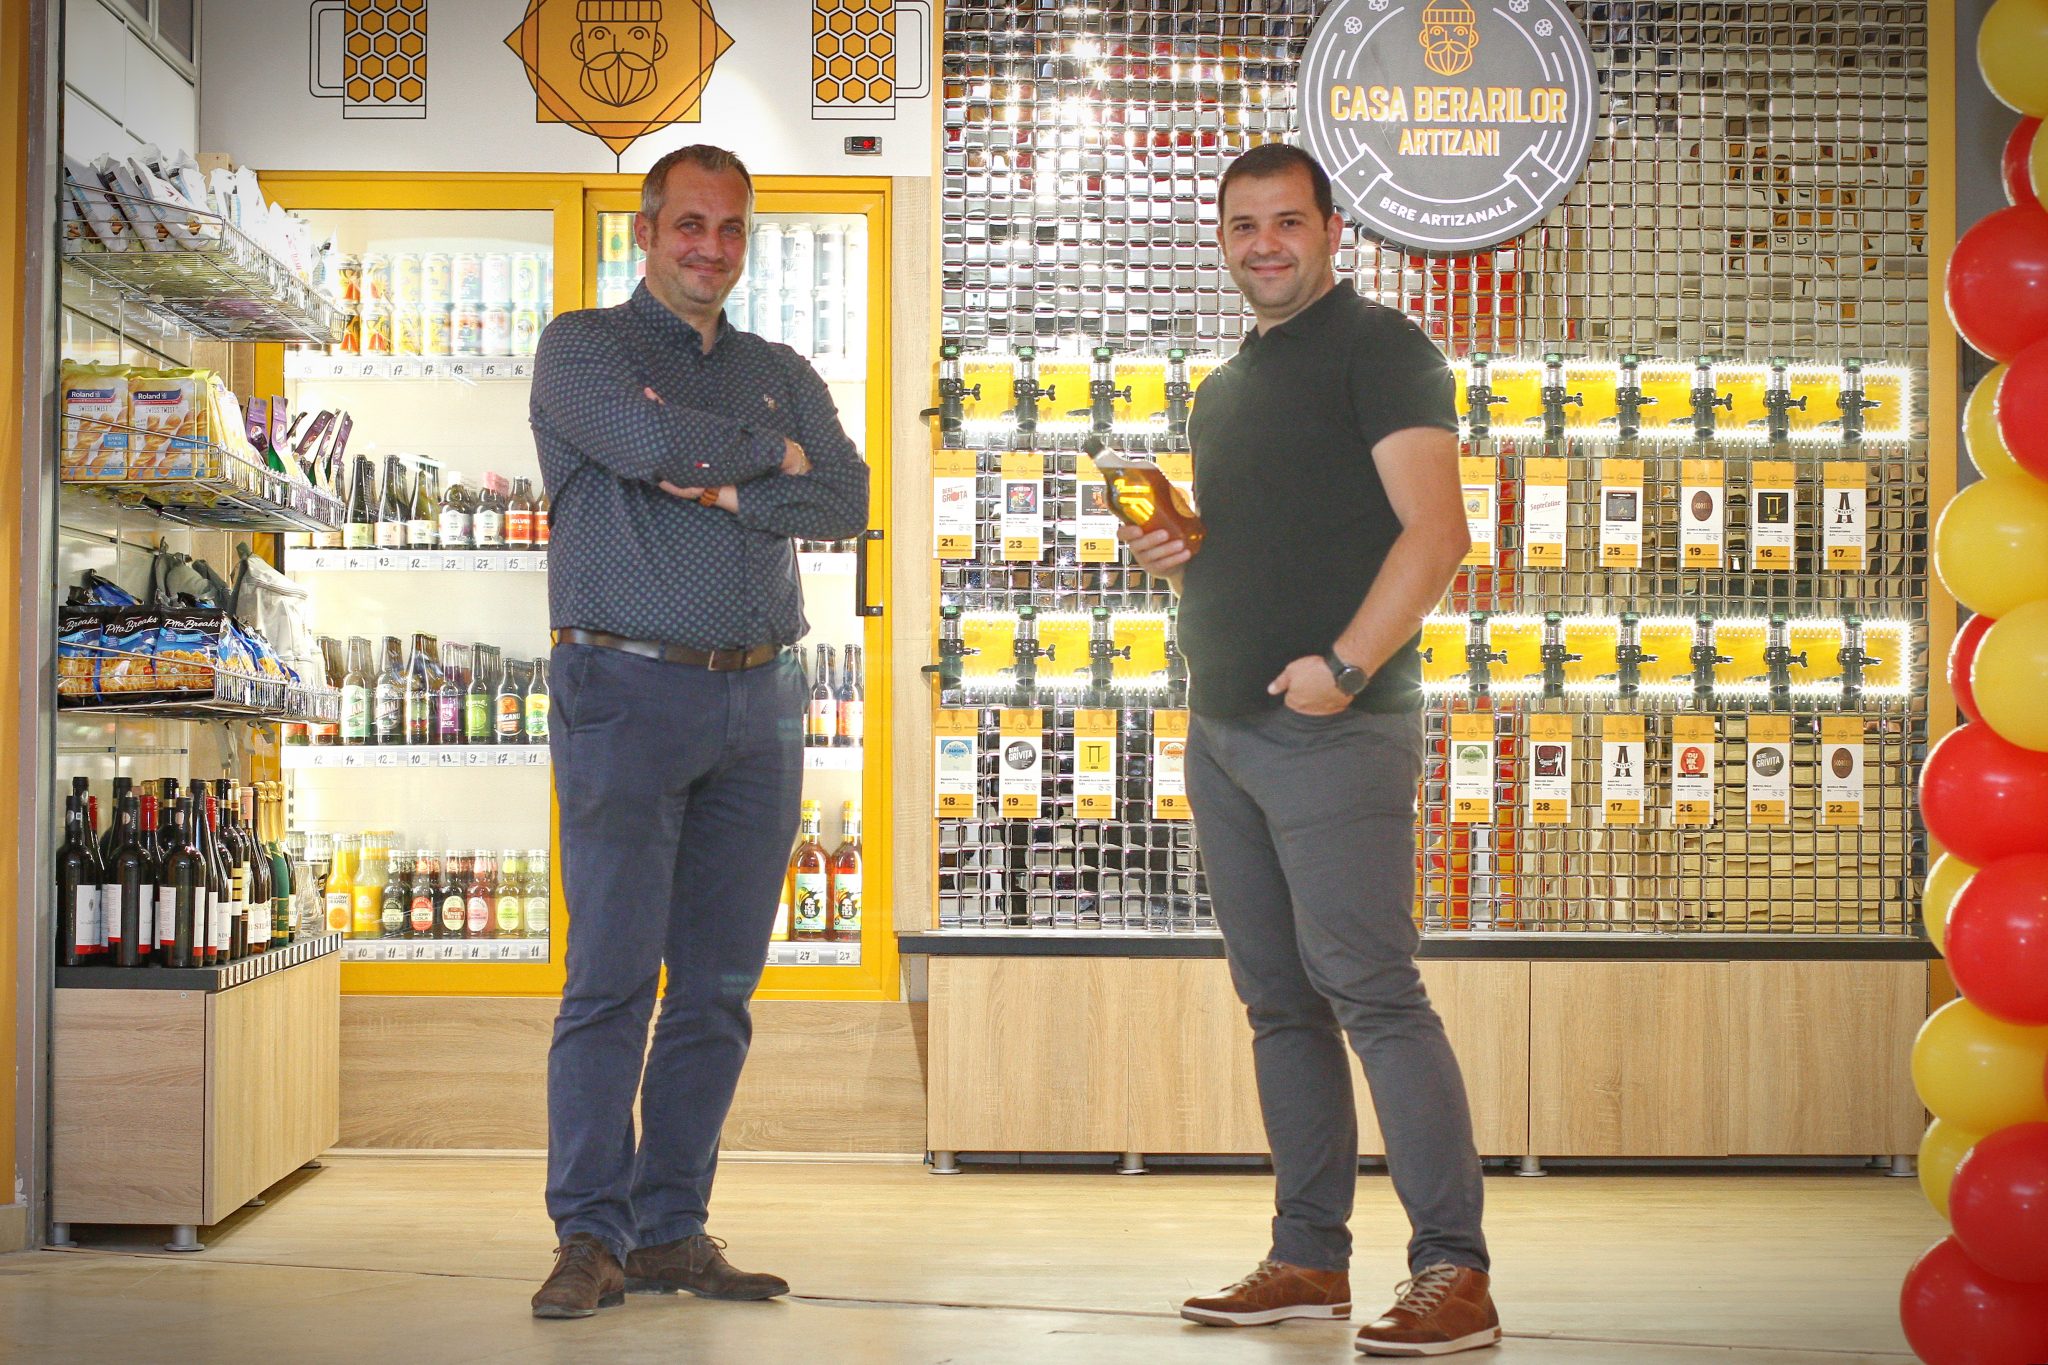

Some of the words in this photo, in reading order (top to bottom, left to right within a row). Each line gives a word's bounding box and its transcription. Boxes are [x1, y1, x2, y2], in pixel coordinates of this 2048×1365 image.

[1330, 86, 1408, 122] CASA
[1414, 86, 1568, 124] BERARILOR
[1398, 128, 1500, 157] ARTIZANI
[1379, 196, 1416, 222] BERE
[1419, 196, 1518, 227] ARTIZANALĂ
[334, 365, 343, 375] 19
[363, 364, 374, 375] 19
[394, 364, 403, 375] 17
[424, 364, 434, 375] 17
[454, 364, 464, 374] 18
[486, 365, 495, 374] 15
[514, 364, 524, 375] 16
[941, 538, 954, 546] 21
[1008, 540, 1023, 548] 23
[1083, 542, 1096, 550] 15
[1532, 546, 1544, 554] 17
[1606, 547, 1620, 556] 25
[1688, 547, 1702, 556] 19
[1760, 549, 1772, 558] 16
[1832, 549, 1845, 557] 17
[350, 558, 358, 568] 14
[379, 558, 390, 567] 13
[411, 558, 420, 568] 12
[445, 559, 456, 569] 27
[477, 558, 489, 569] 27
[508, 558, 519, 569] 15
[66, 616, 98, 632] Breaks
[105, 624, 125, 634] Pita
[125, 616, 158, 632] Breaks
[165, 618, 184, 628] Pita
[184, 618, 220, 630] Breaks
[346, 754, 354, 765] 14
[378, 754, 388, 764] 12
[411, 754, 420, 764] 10
[469, 753, 477, 764] 9
[497, 753, 508, 764] 17
[528, 753, 537, 763] 11
[942, 797, 956, 806] 18
[1006, 798, 1019, 806] 19
[1081, 798, 1094, 806] 16
[1161, 799, 1173, 807] 18
[1458, 802, 1472, 810] 19
[1536, 802, 1550, 811] 28
[1610, 803, 1622, 811] 17
[1679, 804, 1693, 812] 26
[1755, 804, 1768, 812] 19
[1829, 805, 1843, 813] 22
[358, 948, 368, 958] 10
[388, 947, 396, 958] 11
[416, 947, 424, 958] 11
[444, 946, 453, 957] 11
[471, 947, 479, 958] 11
[501, 946, 510, 957] 11
[531, 946, 540, 957] 11
[800, 951, 810, 961] 27
[839, 952, 850, 961] 27
